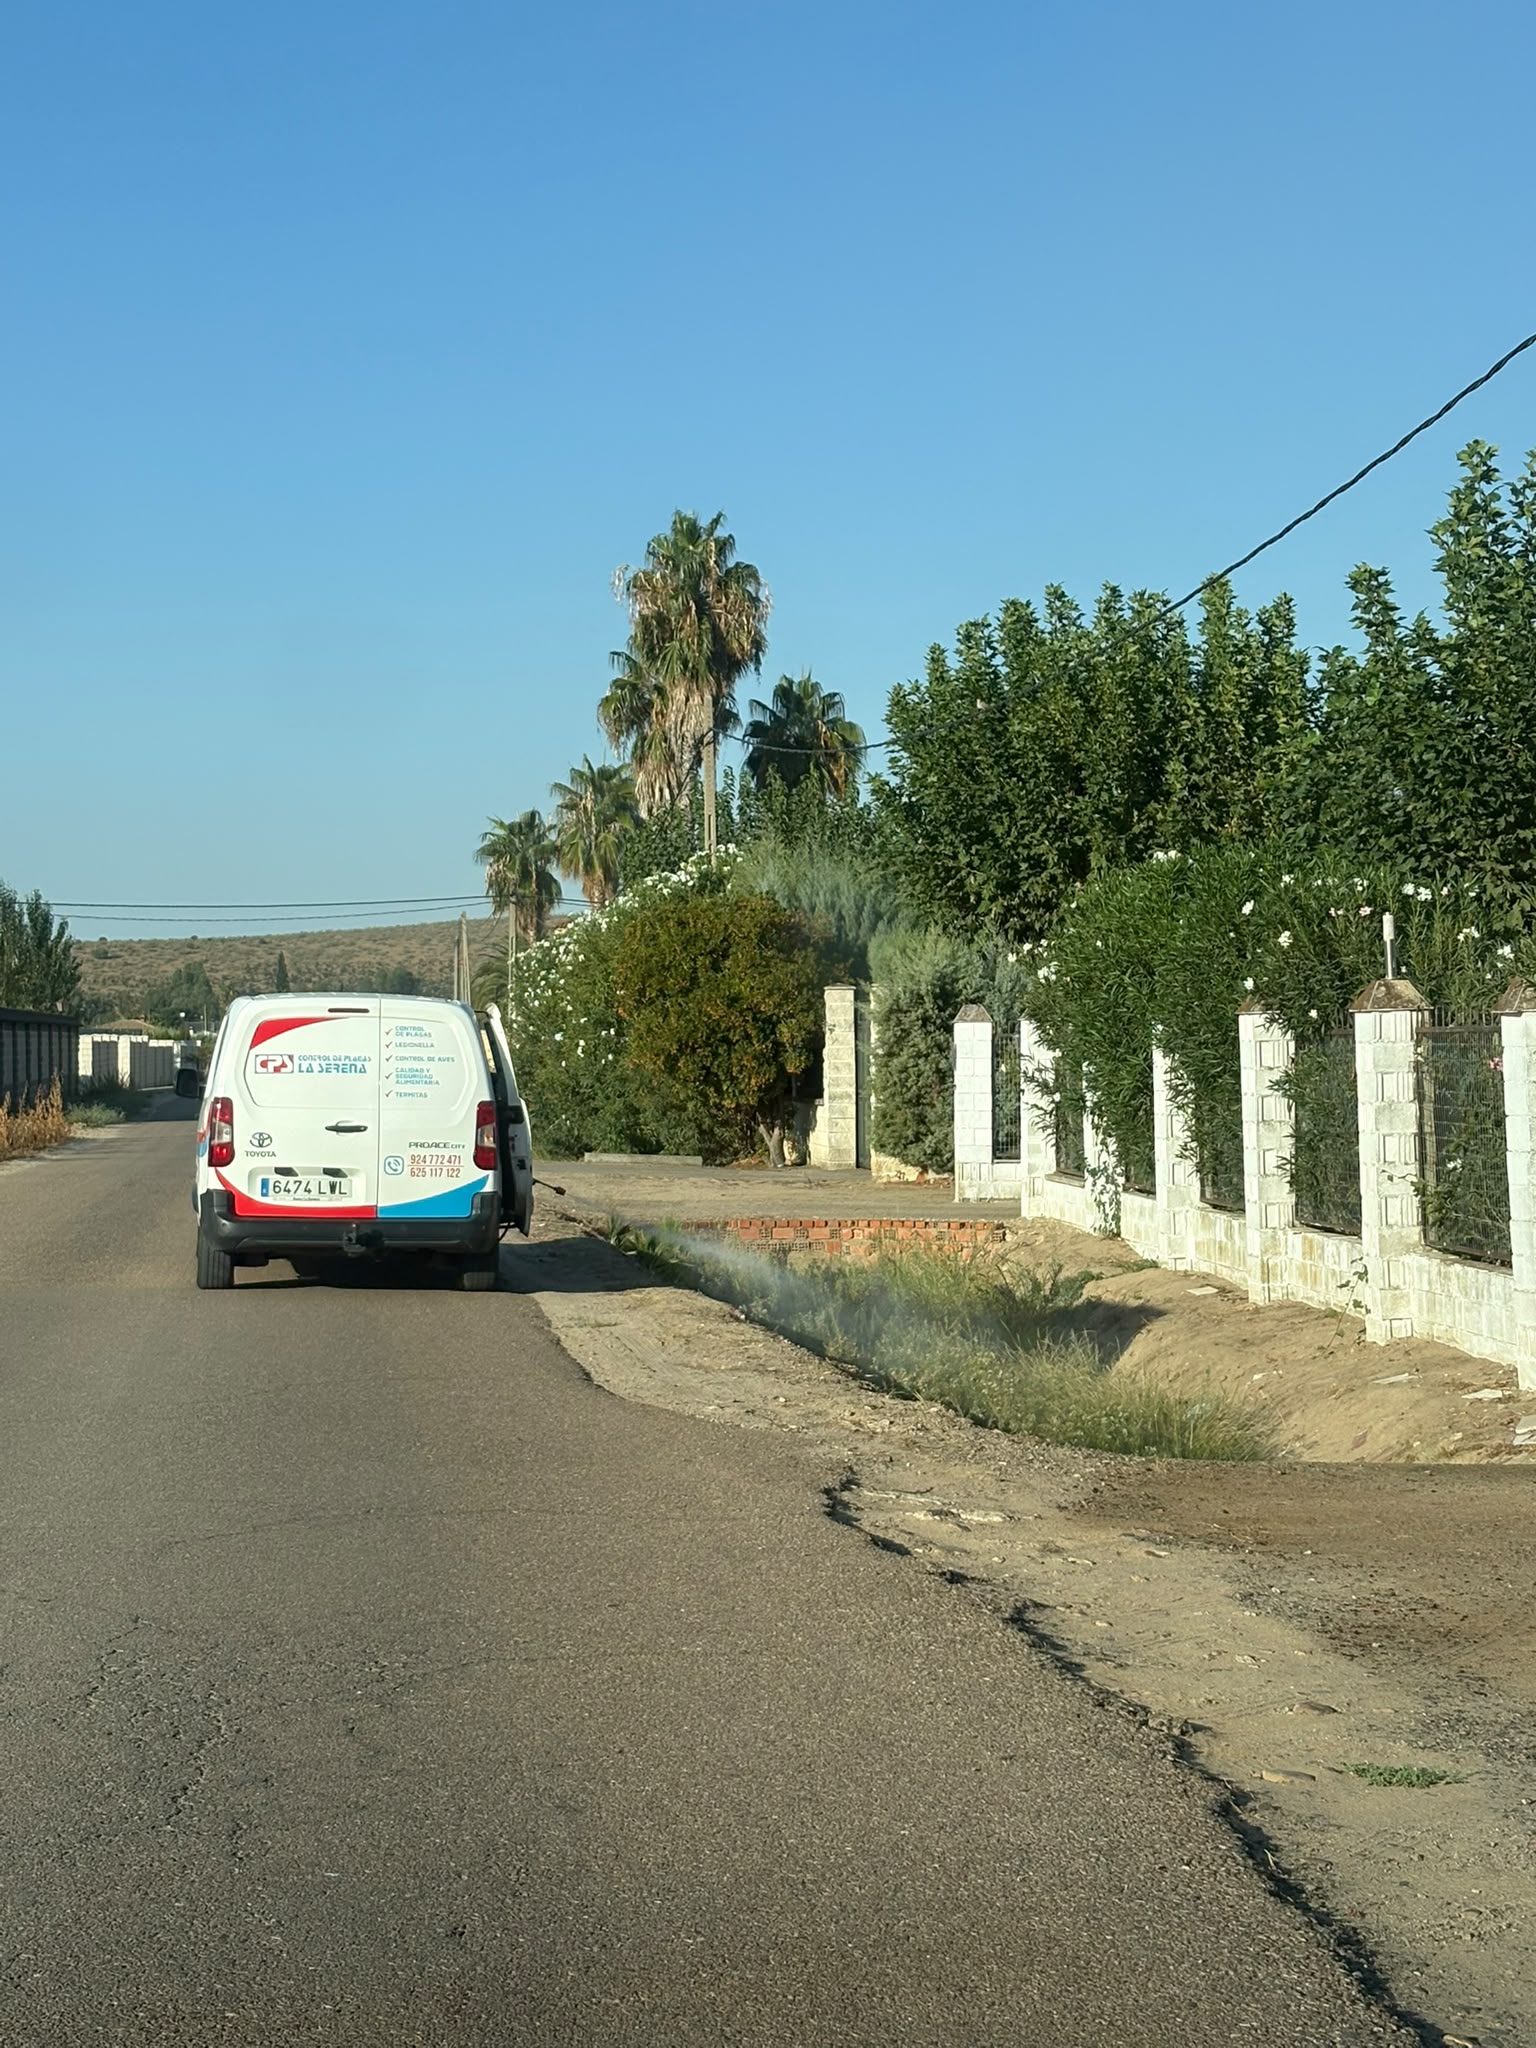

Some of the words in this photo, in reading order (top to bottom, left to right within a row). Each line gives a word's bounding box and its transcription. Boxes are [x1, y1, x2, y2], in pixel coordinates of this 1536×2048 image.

[298, 1063, 314, 1073] LA
[318, 1063, 367, 1073] SERENA
[410, 1154, 427, 1164] 924
[429, 1155, 446, 1164] 772
[447, 1155, 462, 1164] 471
[410, 1167, 427, 1177] 625
[430, 1168, 443, 1177] 117
[447, 1168, 461, 1178] 122
[272, 1180, 312, 1194] 6474
[318, 1181, 347, 1194] LWL
